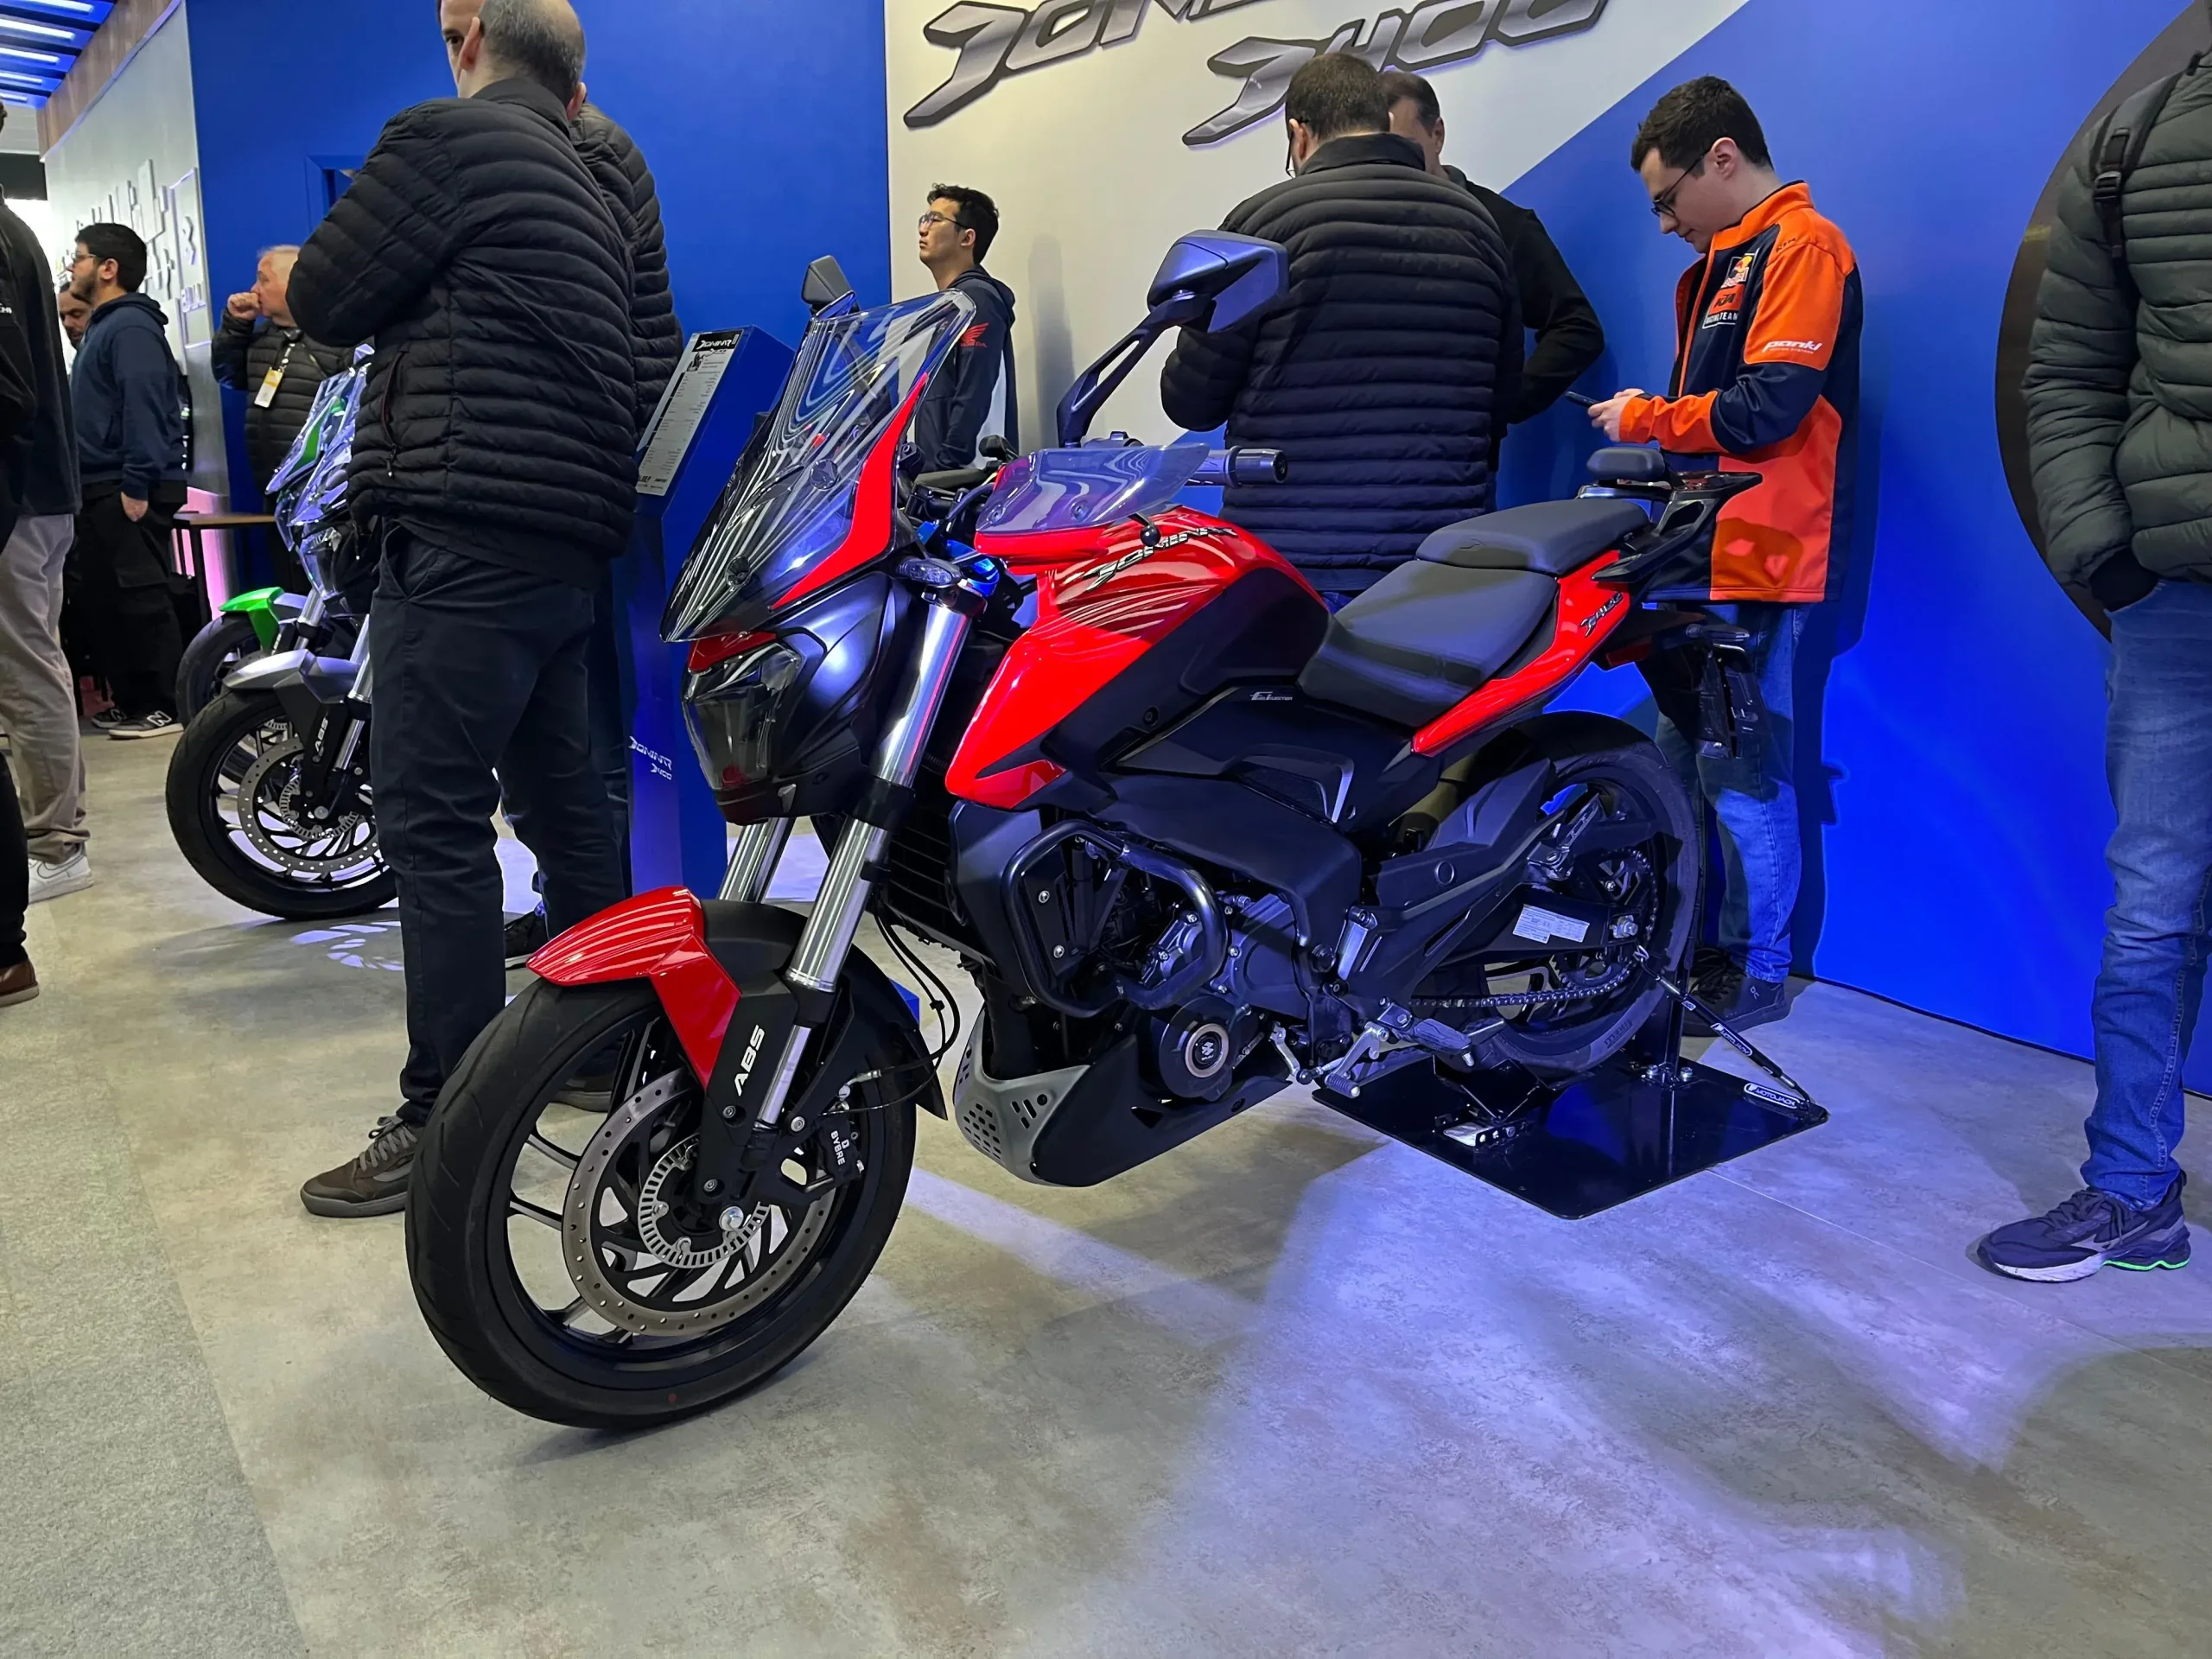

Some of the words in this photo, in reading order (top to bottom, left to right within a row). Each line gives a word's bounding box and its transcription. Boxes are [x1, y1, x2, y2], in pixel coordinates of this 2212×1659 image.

[315, 717, 328, 753] ABS
[734, 1024, 765, 1096] ABS
[830, 1130, 846, 1166] BYBRE
